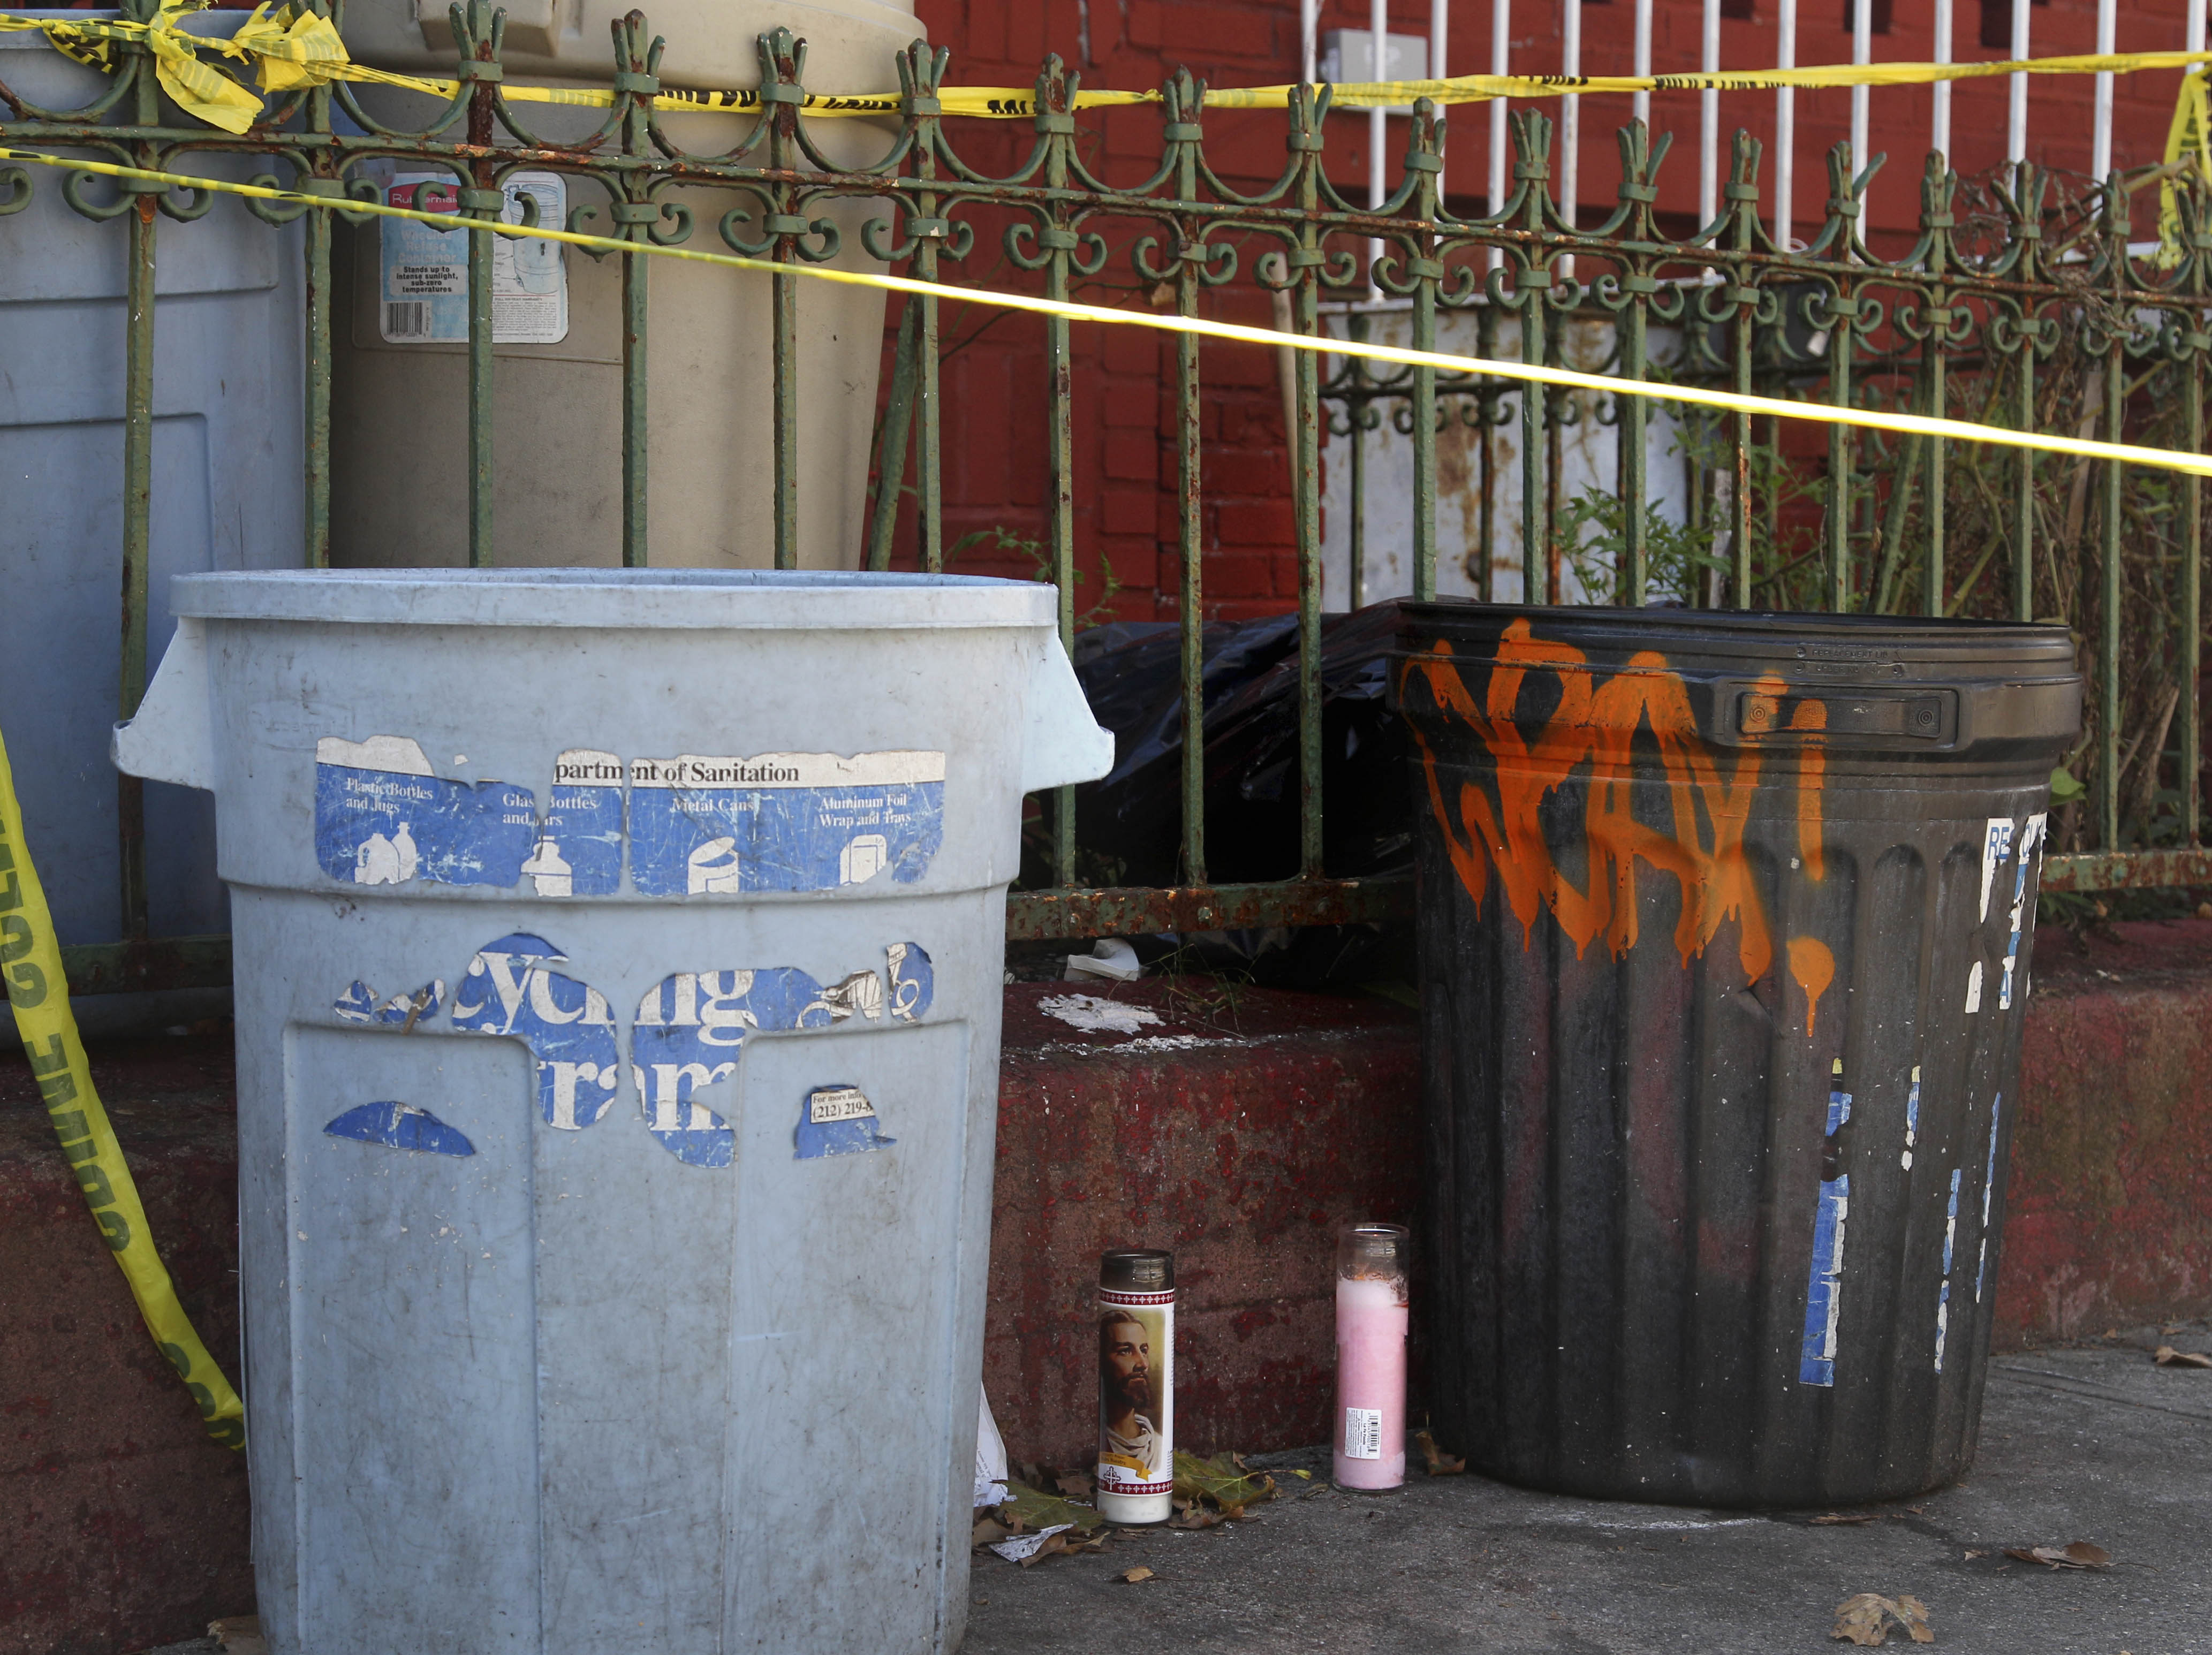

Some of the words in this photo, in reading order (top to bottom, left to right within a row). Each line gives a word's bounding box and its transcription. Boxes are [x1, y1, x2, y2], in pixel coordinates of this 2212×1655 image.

[392, 193, 457, 203] Ruermai
[407, 241, 446, 250] Refuse
[398, 253, 456, 263] Container
[664, 762, 687, 782] of
[691, 761, 800, 783] Sanitation
[347, 777, 385, 795] Plastic
[389, 782, 433, 800] Bottles
[346, 796, 368, 810] and
[372, 798, 400, 816] Jugs
[670, 798, 713, 813] Metal
[718, 798, 754, 812] Cans
[819, 796, 883, 810] Aluminum
[887, 793, 907, 807] Foil
[502, 812, 529, 825] and
[819, 813, 854, 830] Wrap
[857, 811, 879, 826] and
[884, 811, 911, 826] Trays
[813, 1104, 841, 1118] (212)
